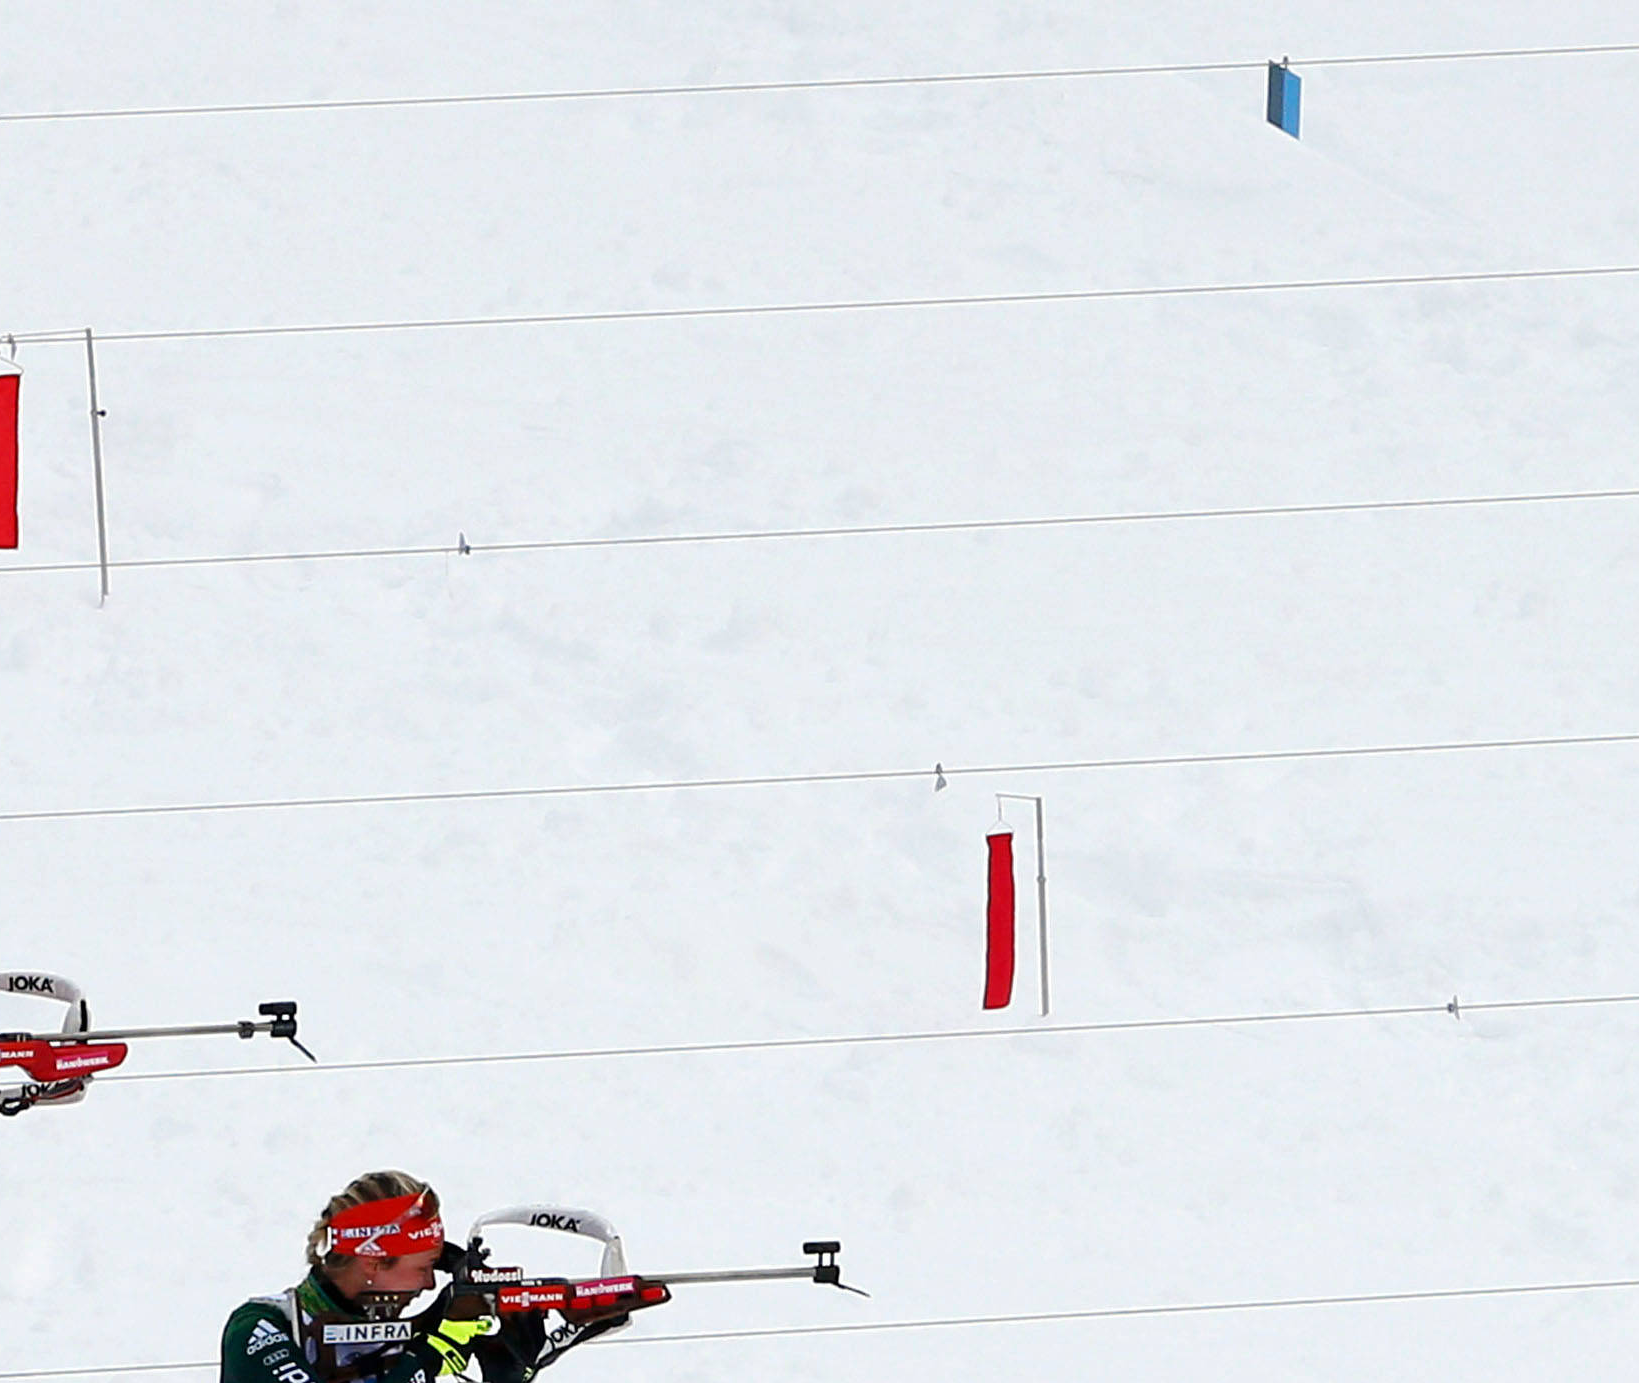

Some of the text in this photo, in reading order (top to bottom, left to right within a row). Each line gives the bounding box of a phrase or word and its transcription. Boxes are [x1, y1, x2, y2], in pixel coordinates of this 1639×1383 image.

[9, 976, 53, 993] JOKA
[22, 1083, 51, 1098] JOK
[530, 1212, 580, 1233] JOKA
[550, 1321, 586, 1344] OKA
[246, 1332, 290, 1356] adidas
